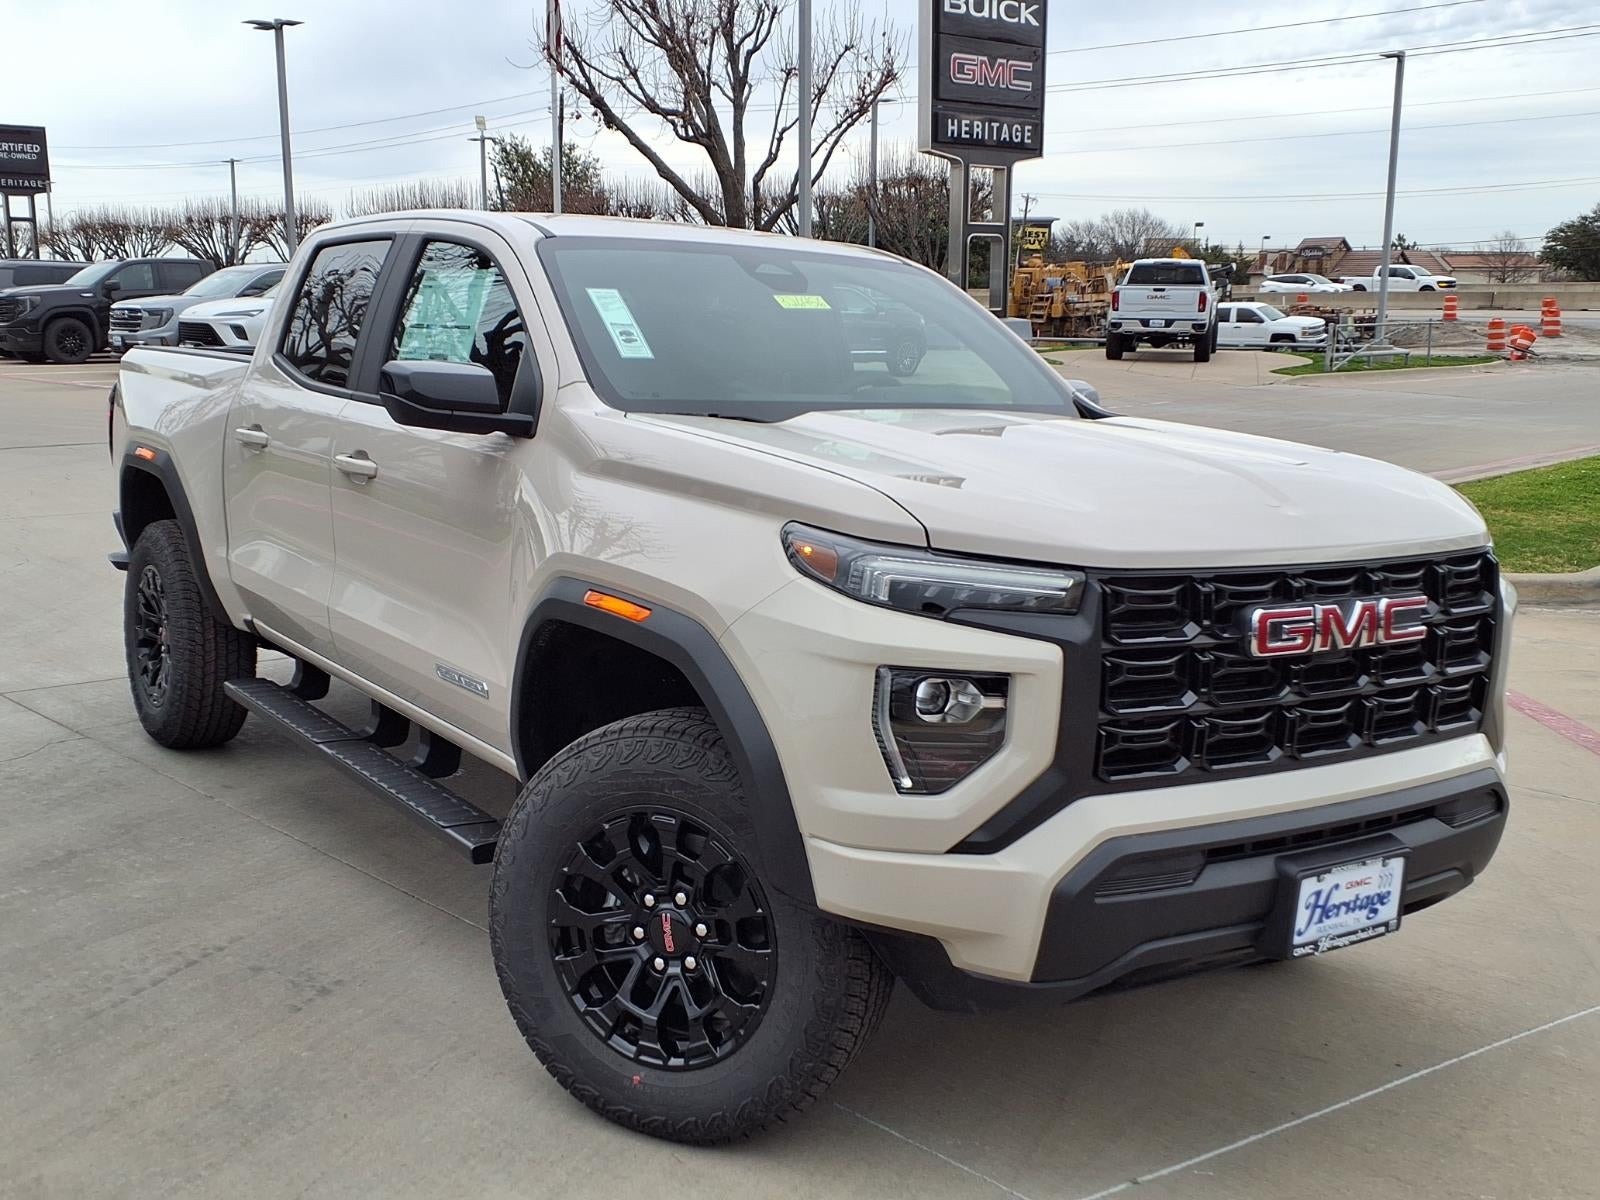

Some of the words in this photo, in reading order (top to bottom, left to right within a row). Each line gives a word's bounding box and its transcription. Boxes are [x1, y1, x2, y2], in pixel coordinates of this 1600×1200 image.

[944, 0, 1040, 26] BUICK
[950, 53, 1033, 91] GMC
[947, 118, 1032, 143] HERITAGE
[0, 143, 40, 153] RTIFIED
[1251, 595, 1428, 657] GMC
[1344, 876, 1373, 890] GMC
[1296, 883, 1392, 937] Heritage
[661, 912, 675, 952] GMC
